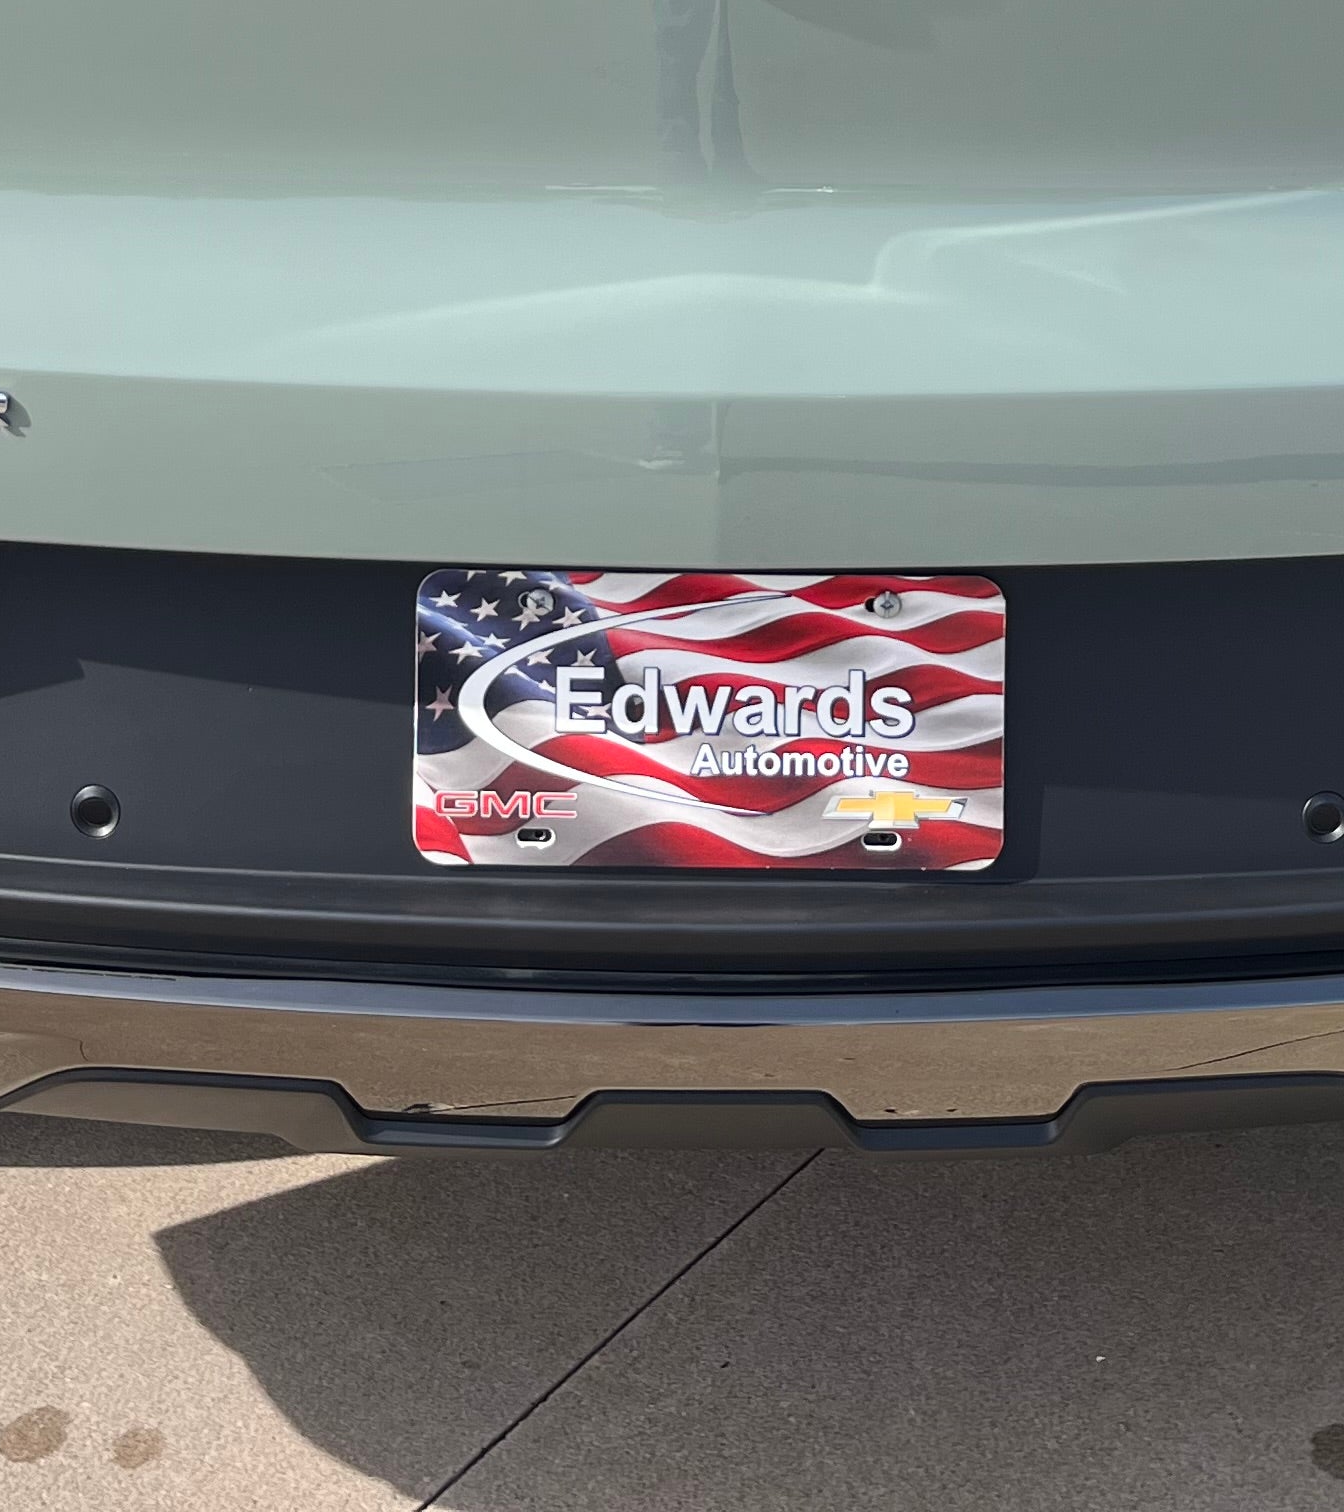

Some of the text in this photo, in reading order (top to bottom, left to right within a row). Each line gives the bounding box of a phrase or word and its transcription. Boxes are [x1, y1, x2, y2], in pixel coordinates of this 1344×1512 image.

[554, 665, 916, 739] Edwards
[690, 742, 910, 778] Automotive
[432, 790, 579, 820] GMC
